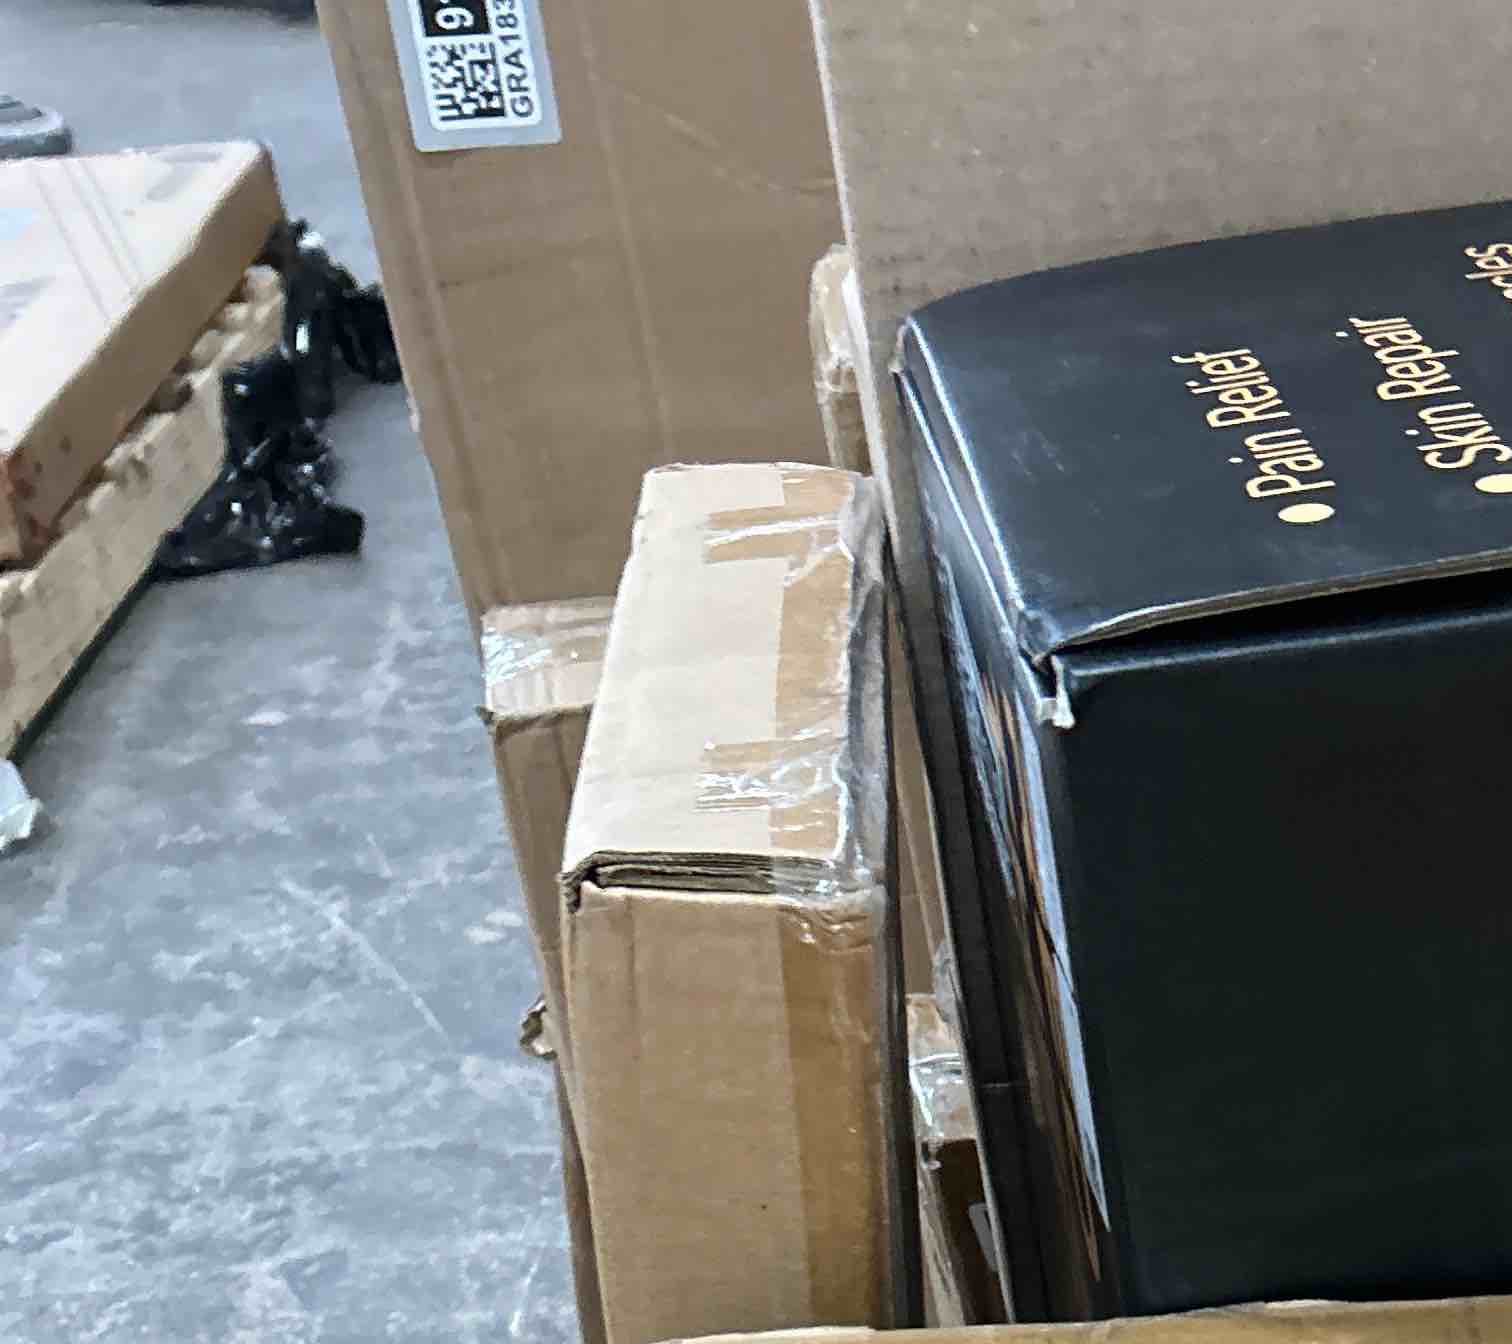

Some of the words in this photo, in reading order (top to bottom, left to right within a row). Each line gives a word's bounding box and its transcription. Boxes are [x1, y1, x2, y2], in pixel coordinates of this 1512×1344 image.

[435, 0, 475, 30] 9
[1170, 347, 1293, 428] Relief
[1334, 315, 1463, 401] Repair
[1227, 427, 1337, 499] Pain
